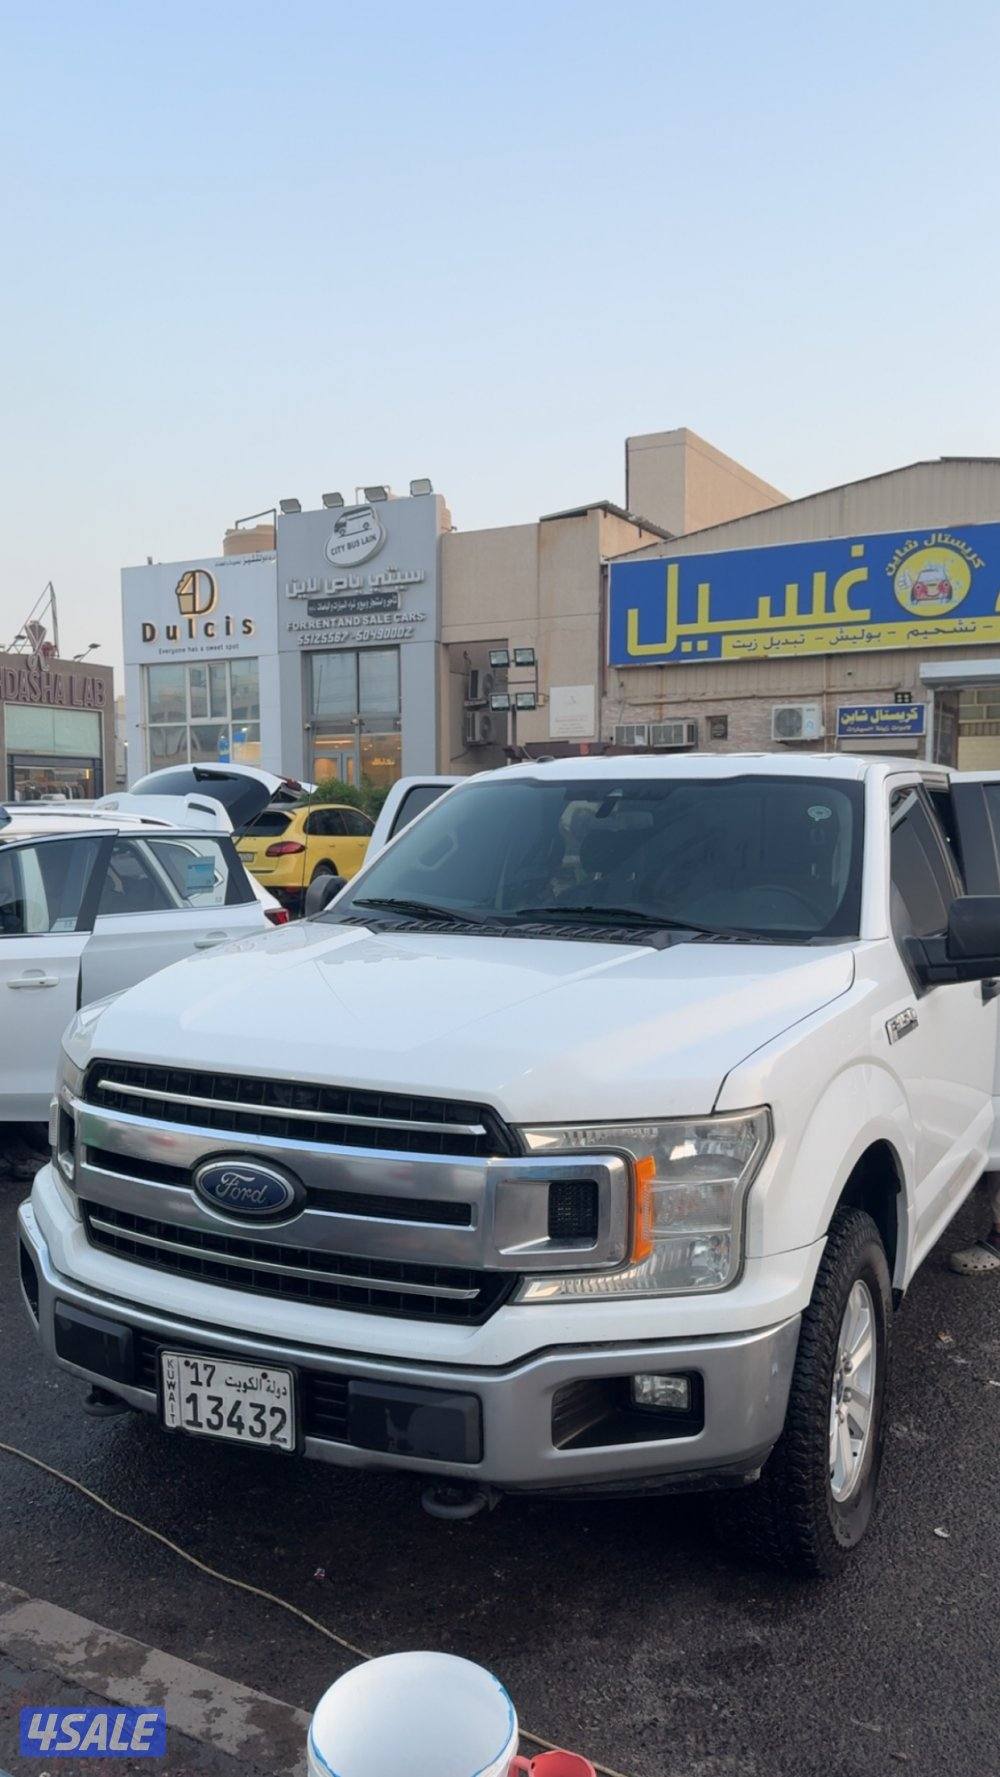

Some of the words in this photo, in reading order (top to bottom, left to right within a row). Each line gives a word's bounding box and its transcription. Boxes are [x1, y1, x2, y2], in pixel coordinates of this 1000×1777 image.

[330, 543, 345, 555] CITY
[347, 540, 360, 550] BUS
[885, 539, 919, 576] شاين
[924, 533, 986, 569] كريستال
[285, 577, 320, 599] لاين
[325, 574, 363, 595] باص
[626, 544, 871, 656] غسيل
[141, 615, 254, 643] Dulcis
[288, 620, 308, 632] FOR
[307, 618, 337, 630] RENT
[338, 616, 361, 627] AND
[362, 613, 392, 625] SALE
[393, 612, 425, 623] CARS
[907, 619, 977, 640] تشحيم
[732, 636, 759, 651] زيت
[763, 634, 806, 650] تبديل
[829, 627, 882, 646] بوليش
[70, 671, 106, 707] LAB
[840, 709, 869, 725] شاين
[870, 707, 918, 723] كريستال
[215, 1171, 268, 1204] Ford
[190, 1362, 216, 1388] 17
[224, 1376, 262, 1394] الكويت
[166, 1359, 176, 1425] KUWAIT
[266, 1379, 287, 1399] دولة
[185, 1393, 288, 1444] 13432
